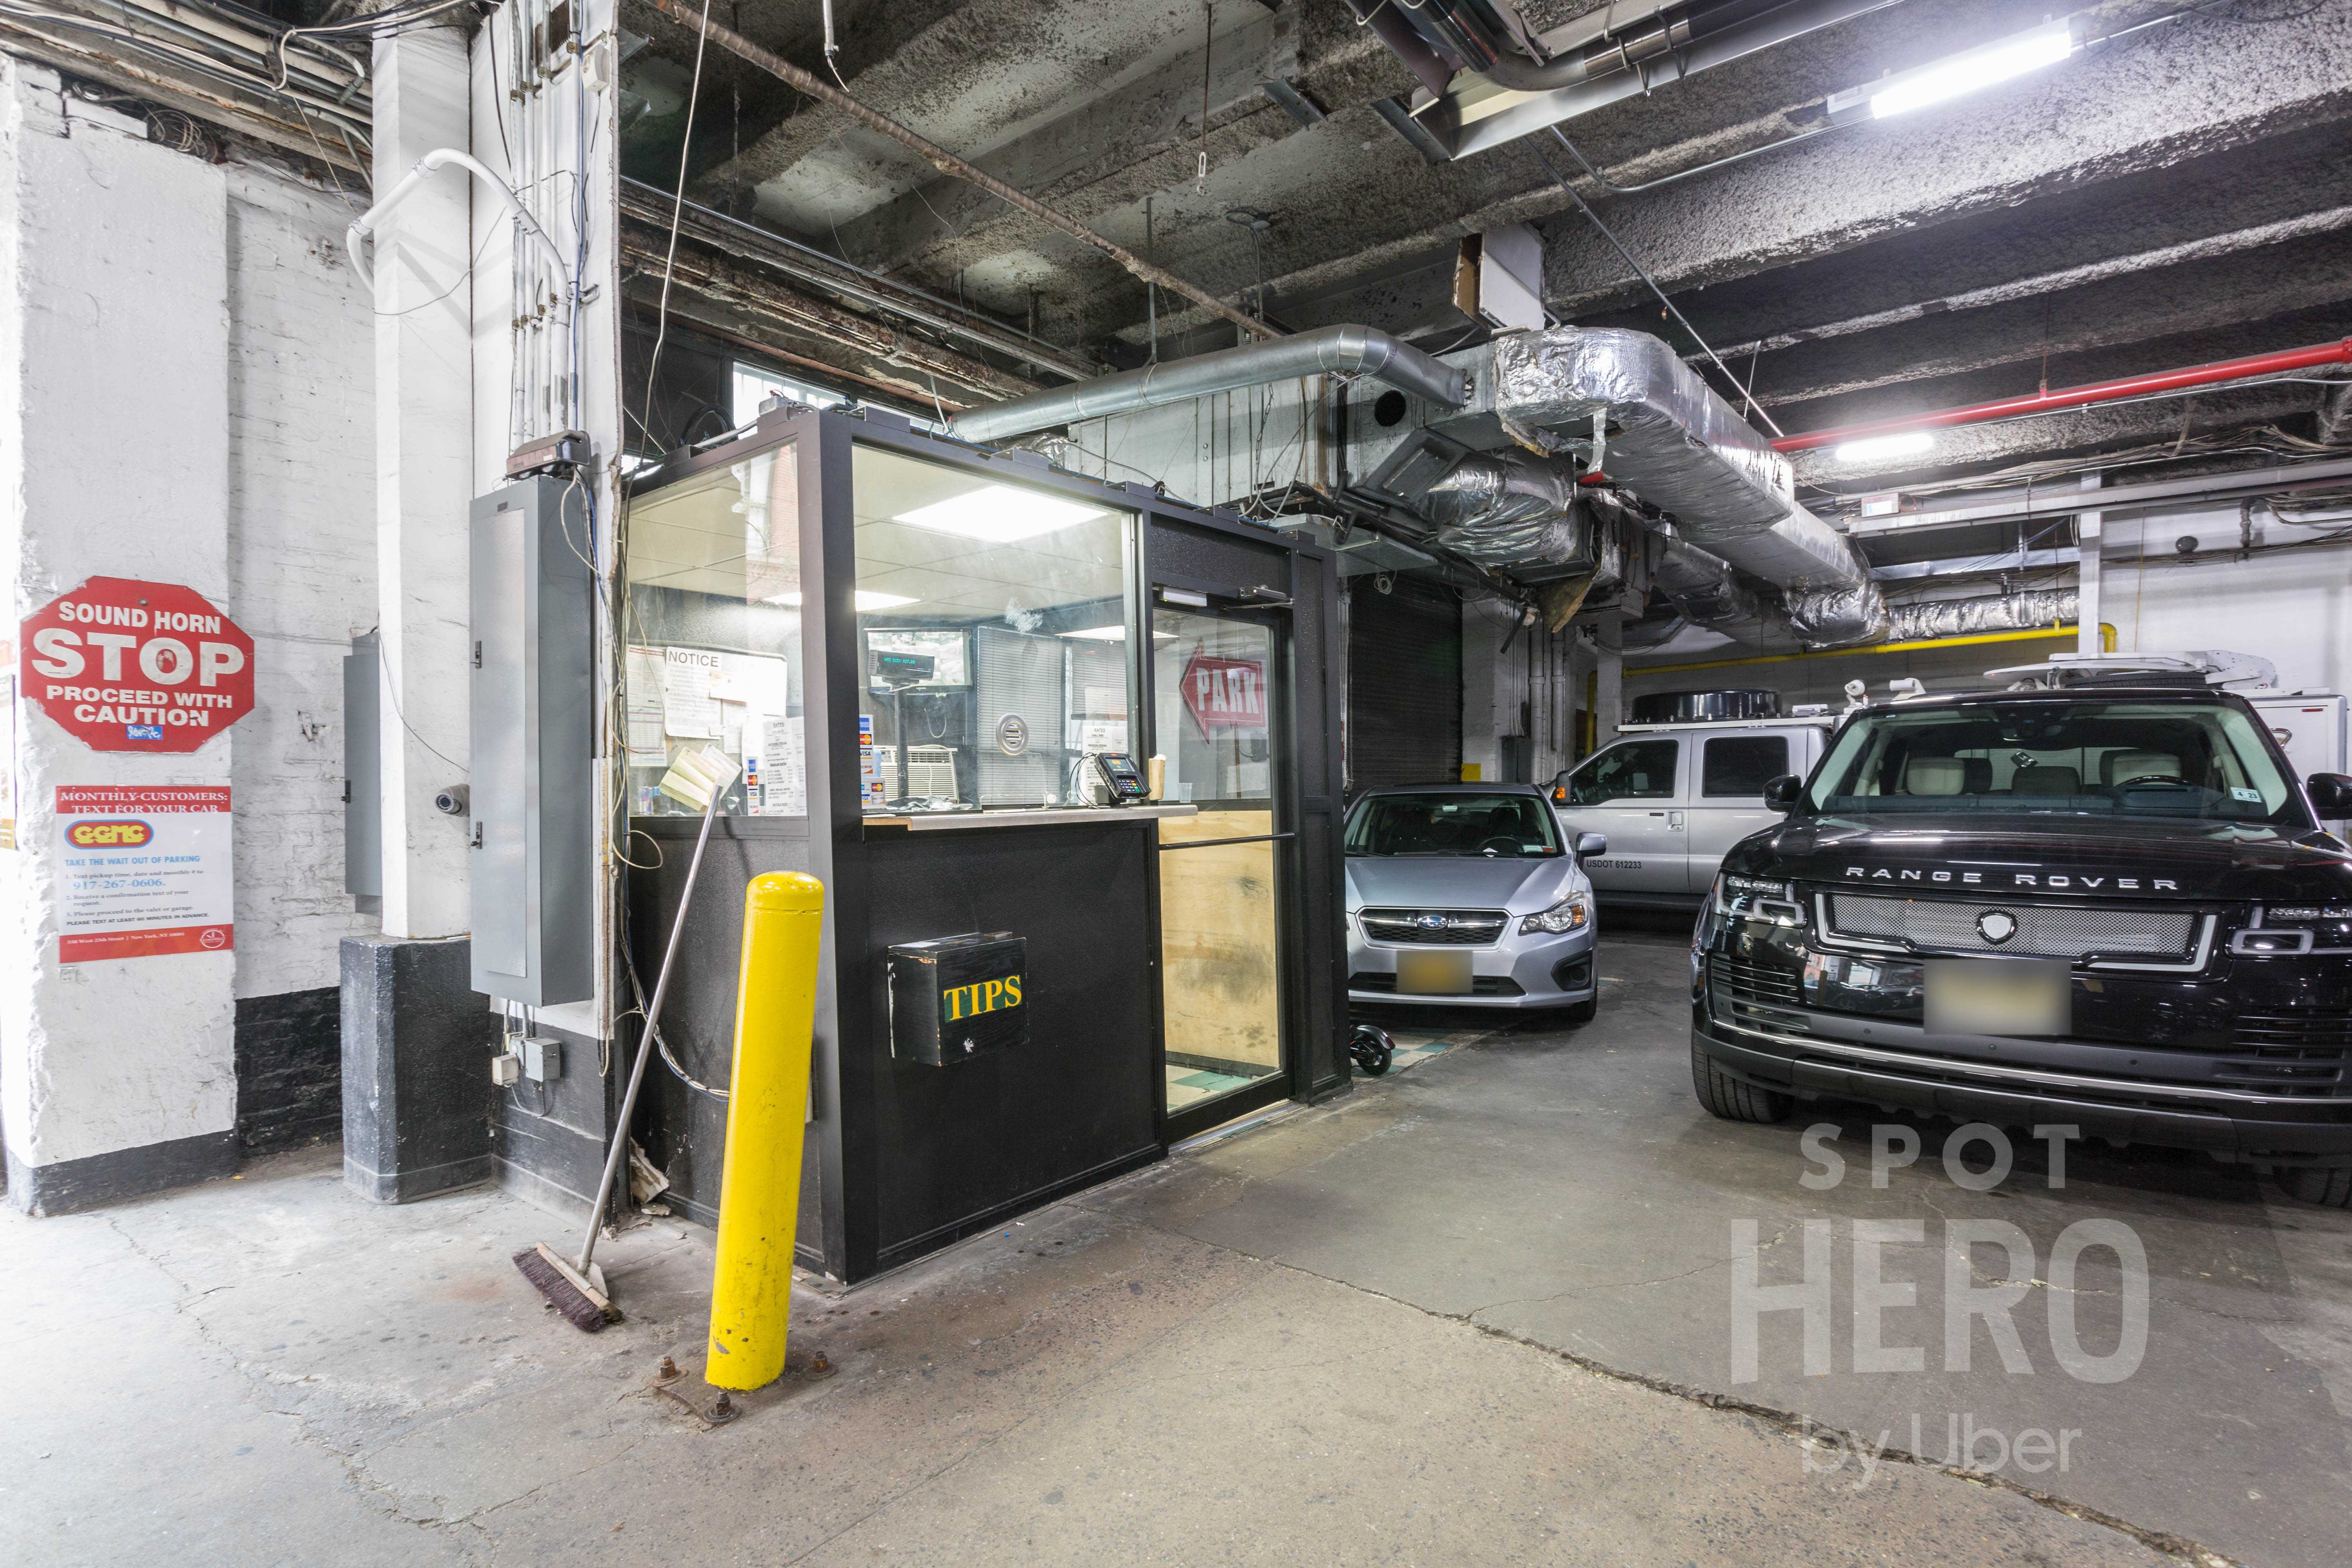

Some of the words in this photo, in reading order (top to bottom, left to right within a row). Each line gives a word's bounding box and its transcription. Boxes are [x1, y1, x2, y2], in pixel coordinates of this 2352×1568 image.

[59, 601, 148, 628] SOUND
[155, 610, 220, 634] HORN
[32, 628, 244, 687] STOP
[669, 651, 718, 667] NOTICE
[47, 685, 168, 705] PROCEED
[175, 692, 232, 708] WITH
[1196, 668, 1259, 714] PARK
[74, 705, 208, 726] CAUTION
[60, 792, 136, 801] MONTHLY
[140, 792, 228, 801] CUSTOMERS:
[72, 805, 111, 813] TEXT
[115, 805, 144, 813] FOR
[147, 804, 187, 813] YOUR
[190, 804, 218, 813] CAR
[74, 825, 145, 844] GGMC
[1587, 860, 1613, 868] USDOT
[1615, 861, 1642, 869] 612233
[73, 880, 165, 889] 917-267-0606.
[1846, 866, 1982, 883] RANGE
[2015, 874, 2178, 890] ROVER
[944, 976, 1022, 1020] TIPS
